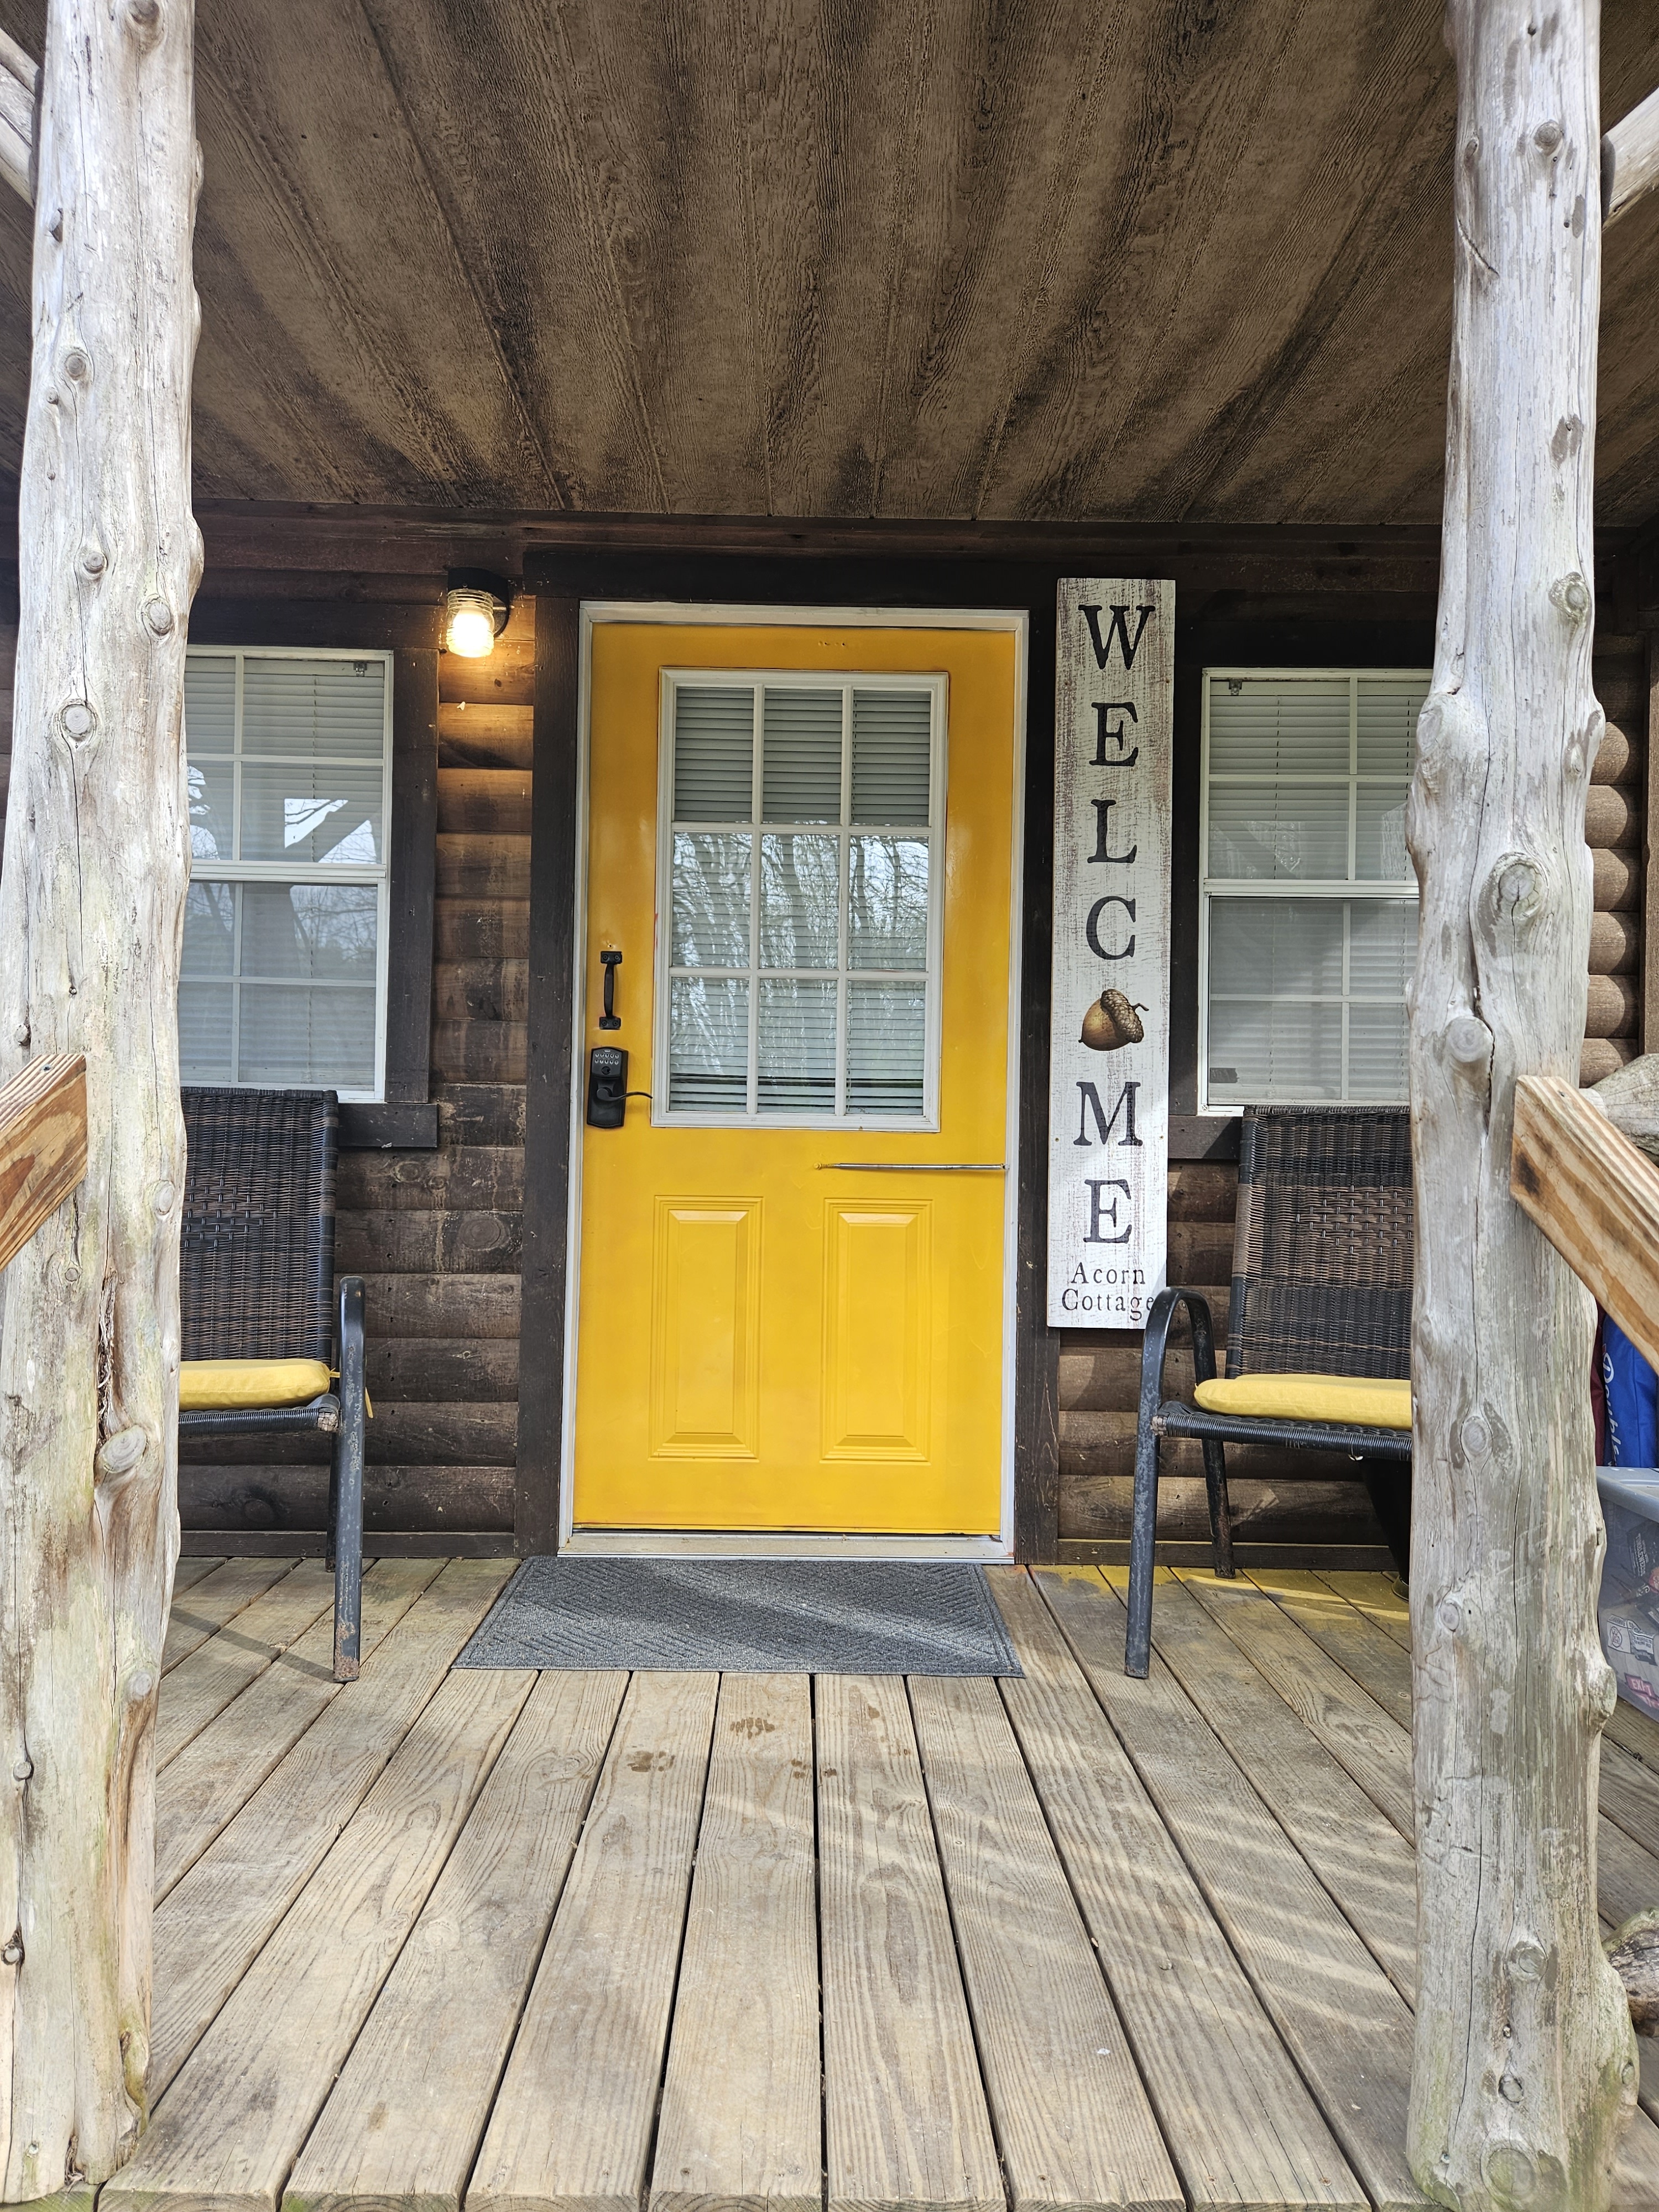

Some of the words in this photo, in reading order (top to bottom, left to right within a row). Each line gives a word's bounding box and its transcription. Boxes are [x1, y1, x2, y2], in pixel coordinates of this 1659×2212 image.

[1073, 604, 1155, 1244] WELCME
[1071, 1262, 1145, 1284] Acorn
[1062, 1288, 1154, 1321] Cottage
